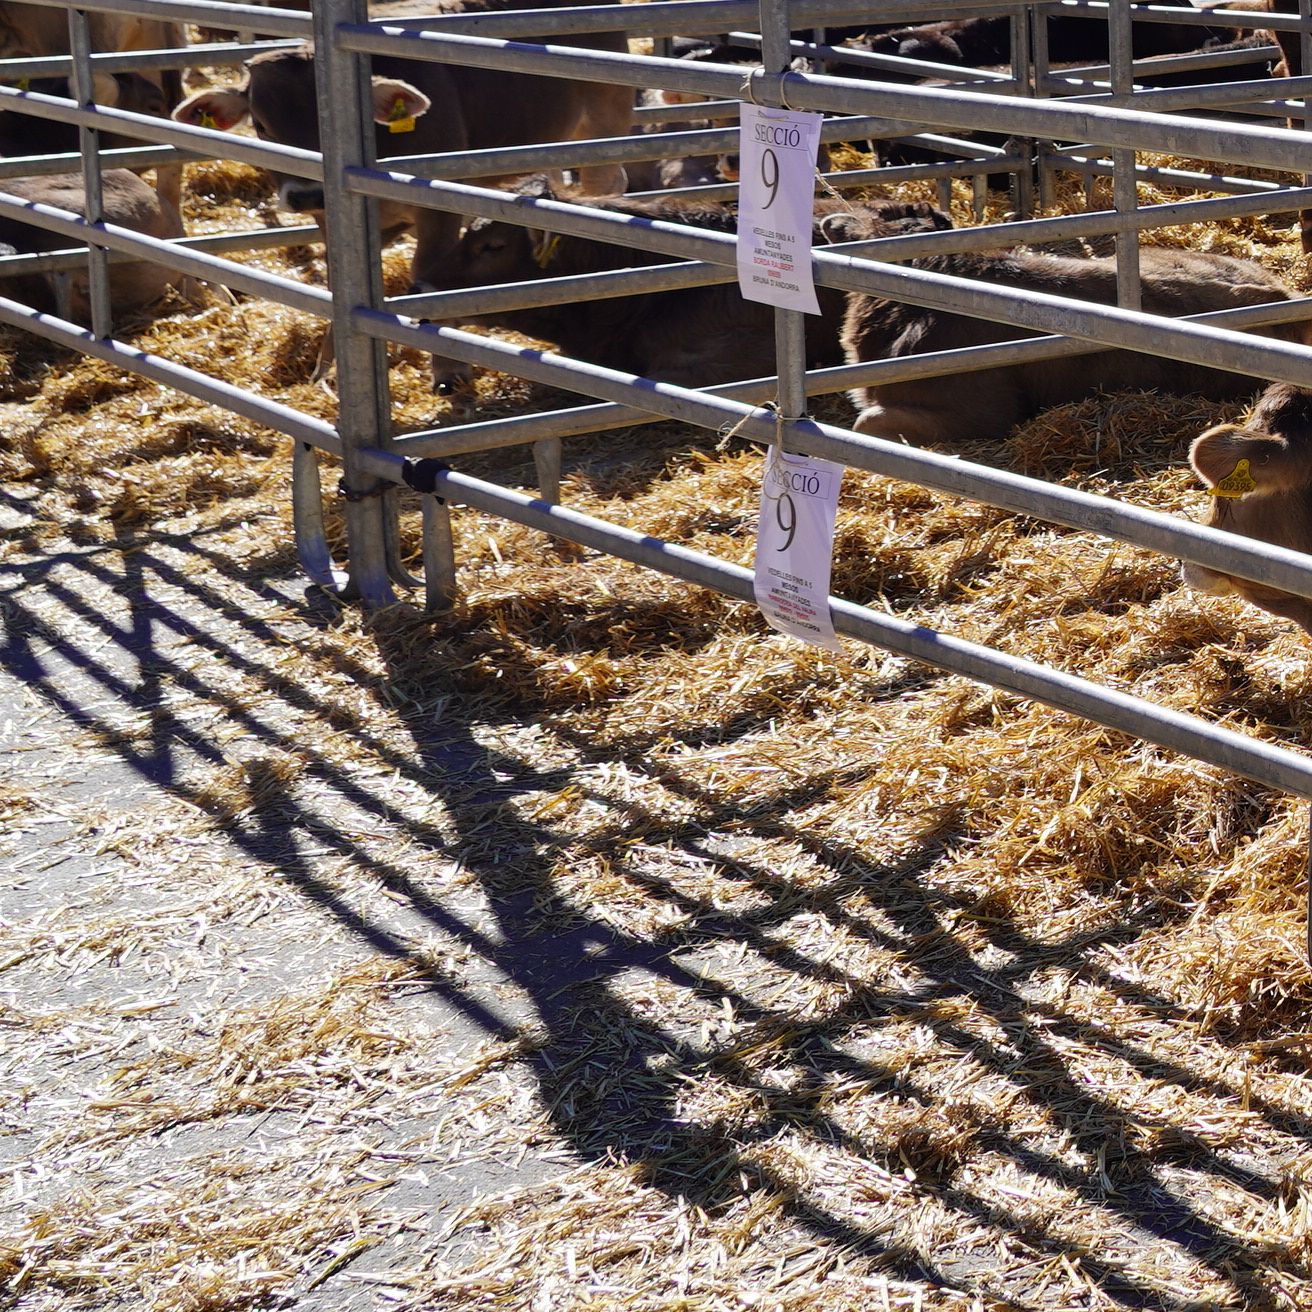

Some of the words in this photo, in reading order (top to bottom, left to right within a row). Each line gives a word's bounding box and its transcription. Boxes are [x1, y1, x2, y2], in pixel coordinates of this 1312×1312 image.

[754, 122, 801, 148] SECCIÓ
[761, 148, 780, 210] 9
[771, 463, 820, 496] SECCIÓ
[776, 493, 797, 552] 9
